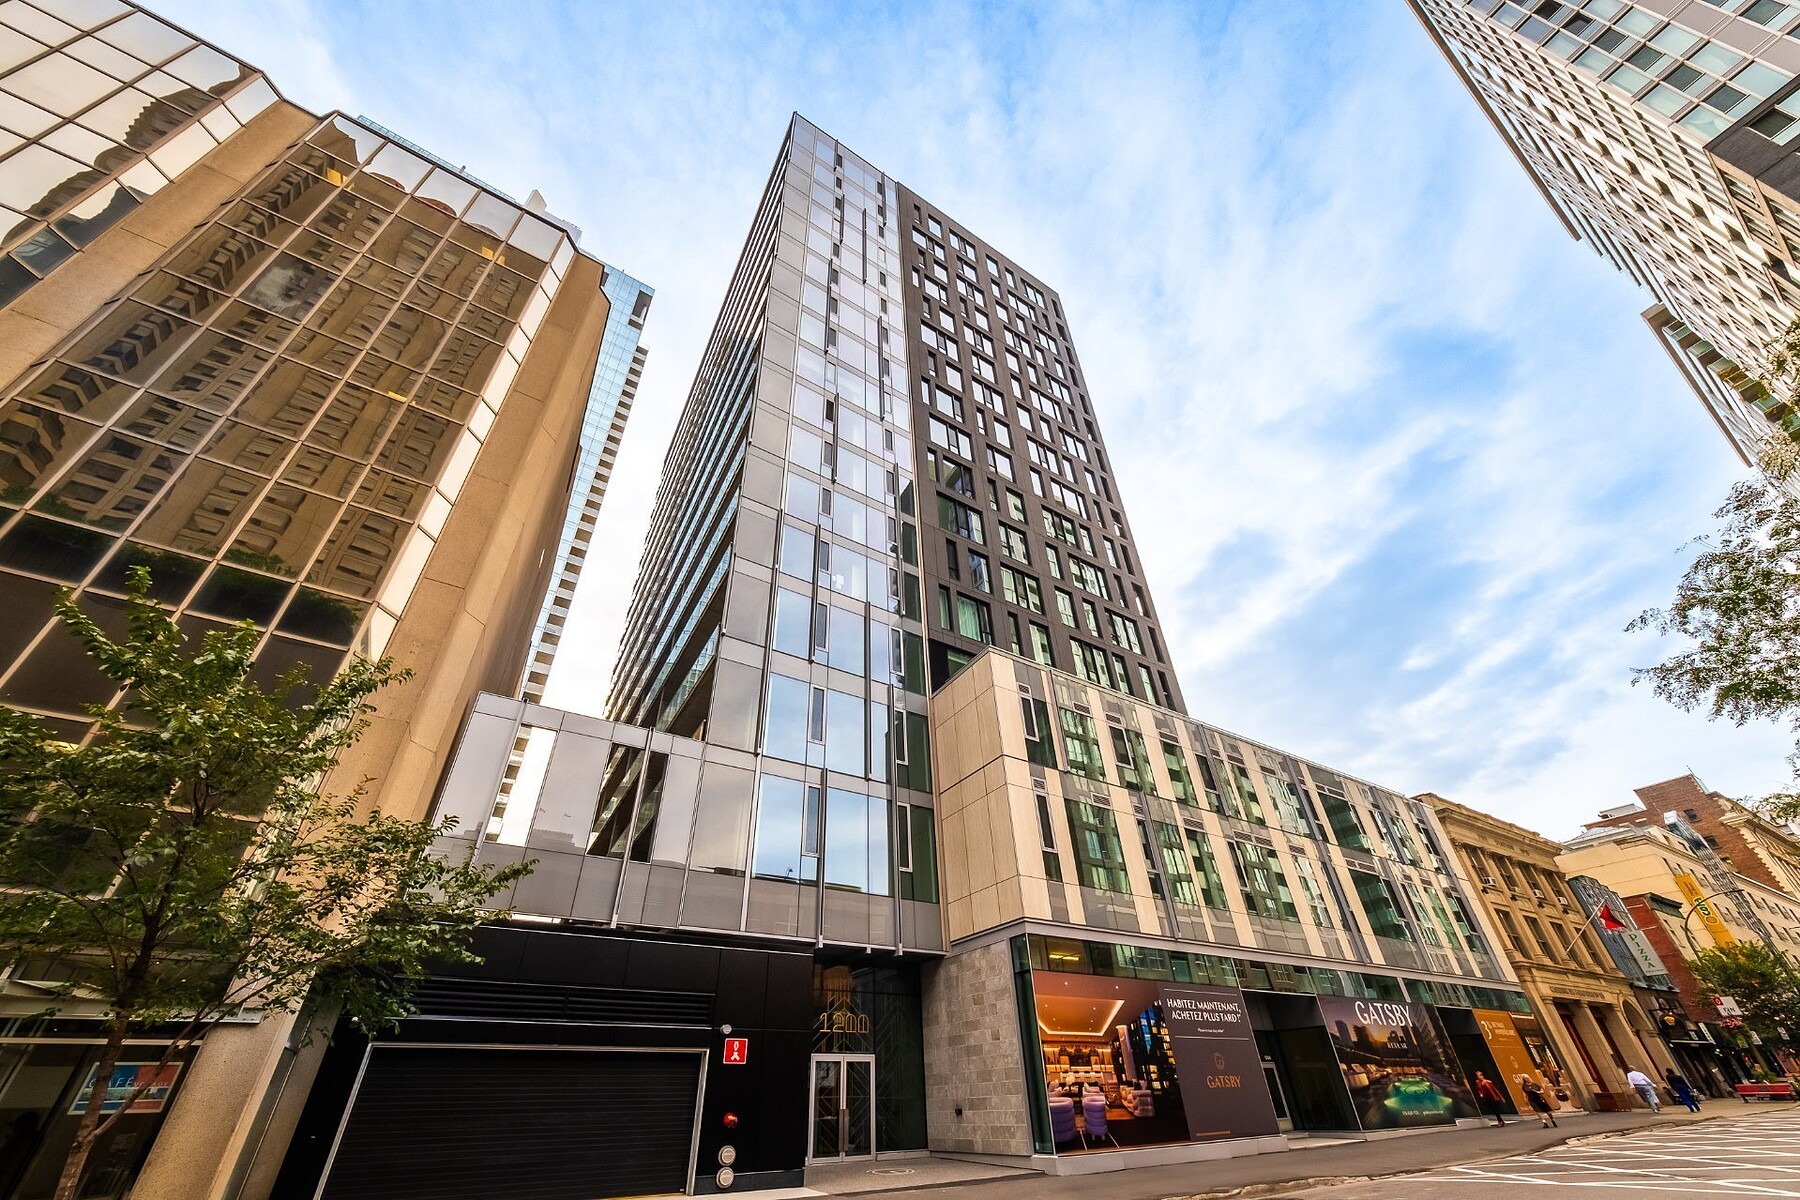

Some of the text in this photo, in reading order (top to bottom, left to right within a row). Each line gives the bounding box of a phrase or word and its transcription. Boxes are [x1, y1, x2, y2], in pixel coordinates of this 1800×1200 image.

[1628, 933, 1656, 968] PIZZA
[1166, 998, 1242, 1014] HABITEZ MAINTENANT,
[1354, 1000, 1413, 1027] GATSBY
[820, 1012, 870, 1033] 1200
[1171, 1010, 1203, 1021] ACHETEZ
[1202, 1012, 1220, 1022] PLUS
[1206, 1075, 1241, 1088] GATSBY
